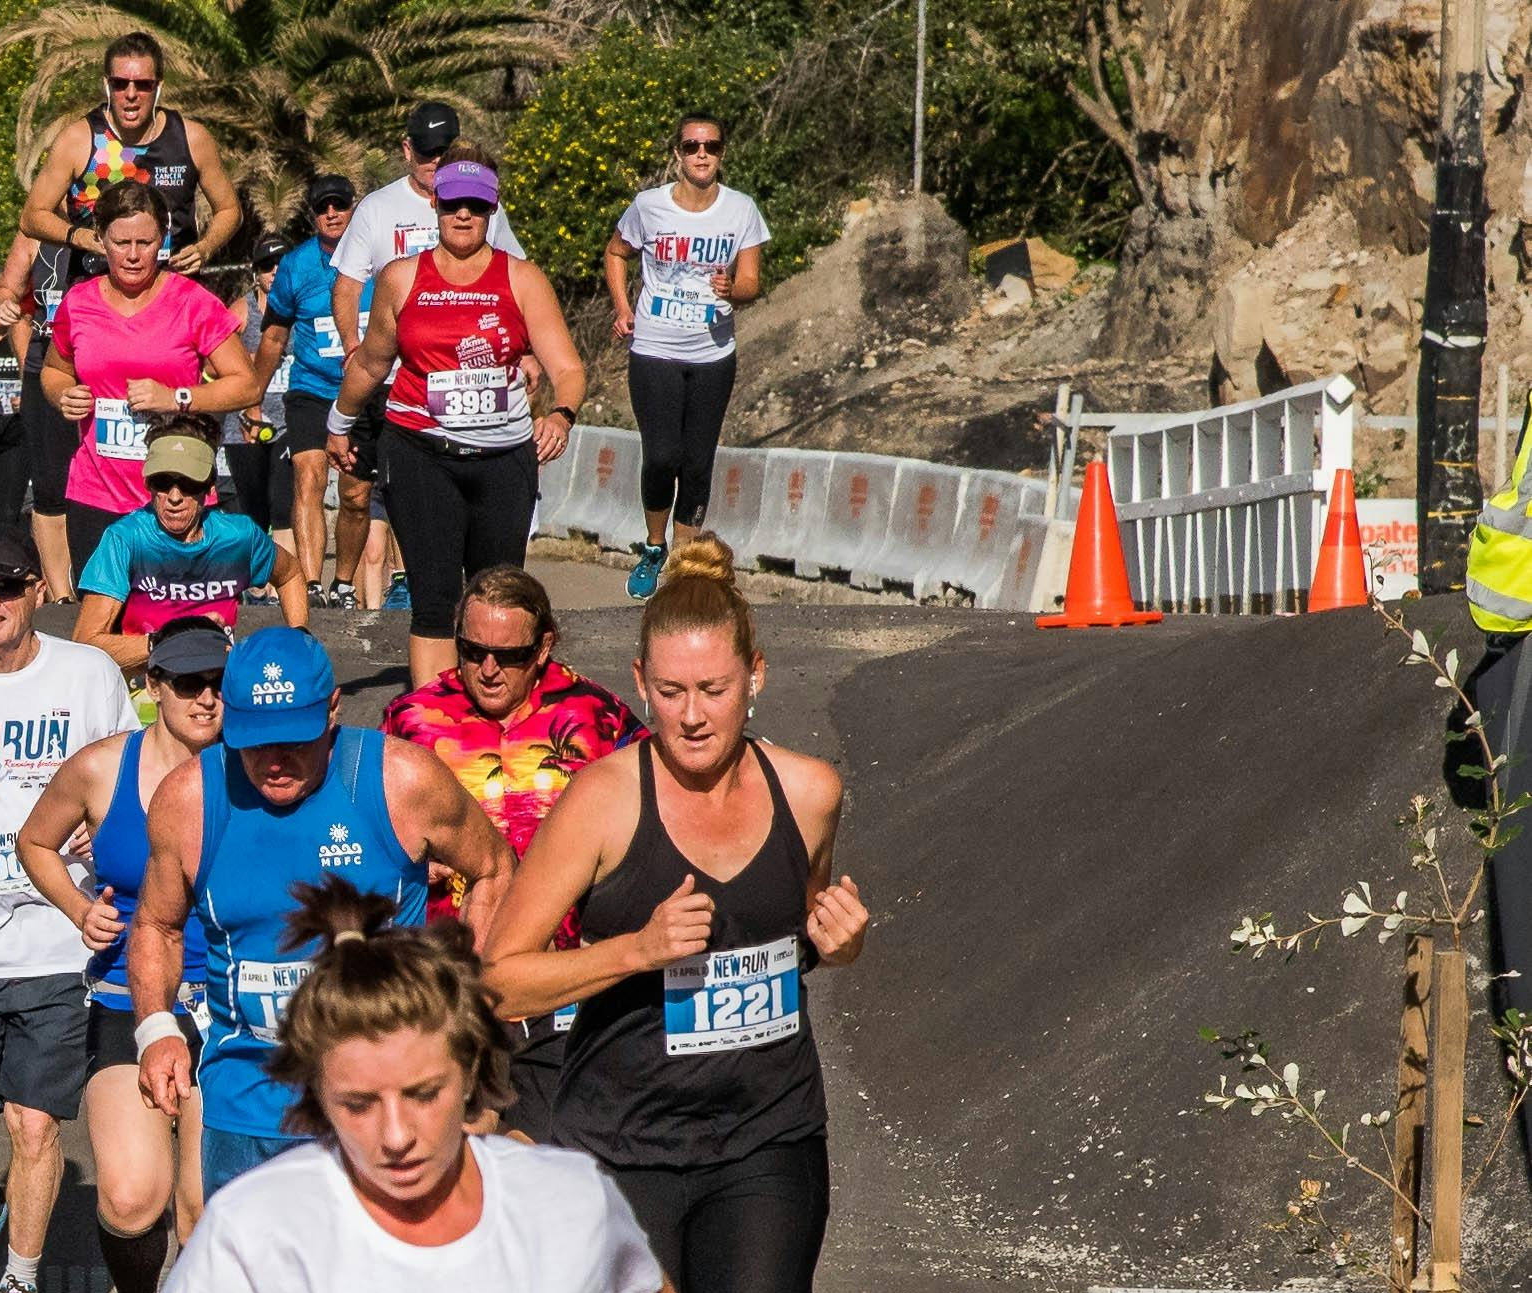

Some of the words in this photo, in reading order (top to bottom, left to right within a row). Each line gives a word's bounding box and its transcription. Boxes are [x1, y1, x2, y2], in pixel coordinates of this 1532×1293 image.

[445, 390, 496, 415] 398
[106, 420, 149, 448] 102
[1359, 520, 1417, 544] oate
[169, 579, 238, 601] RSPT
[253, 693, 294, 705] MBFC
[321, 857, 362, 867] MBFC
[693, 978, 783, 1031] 1221
